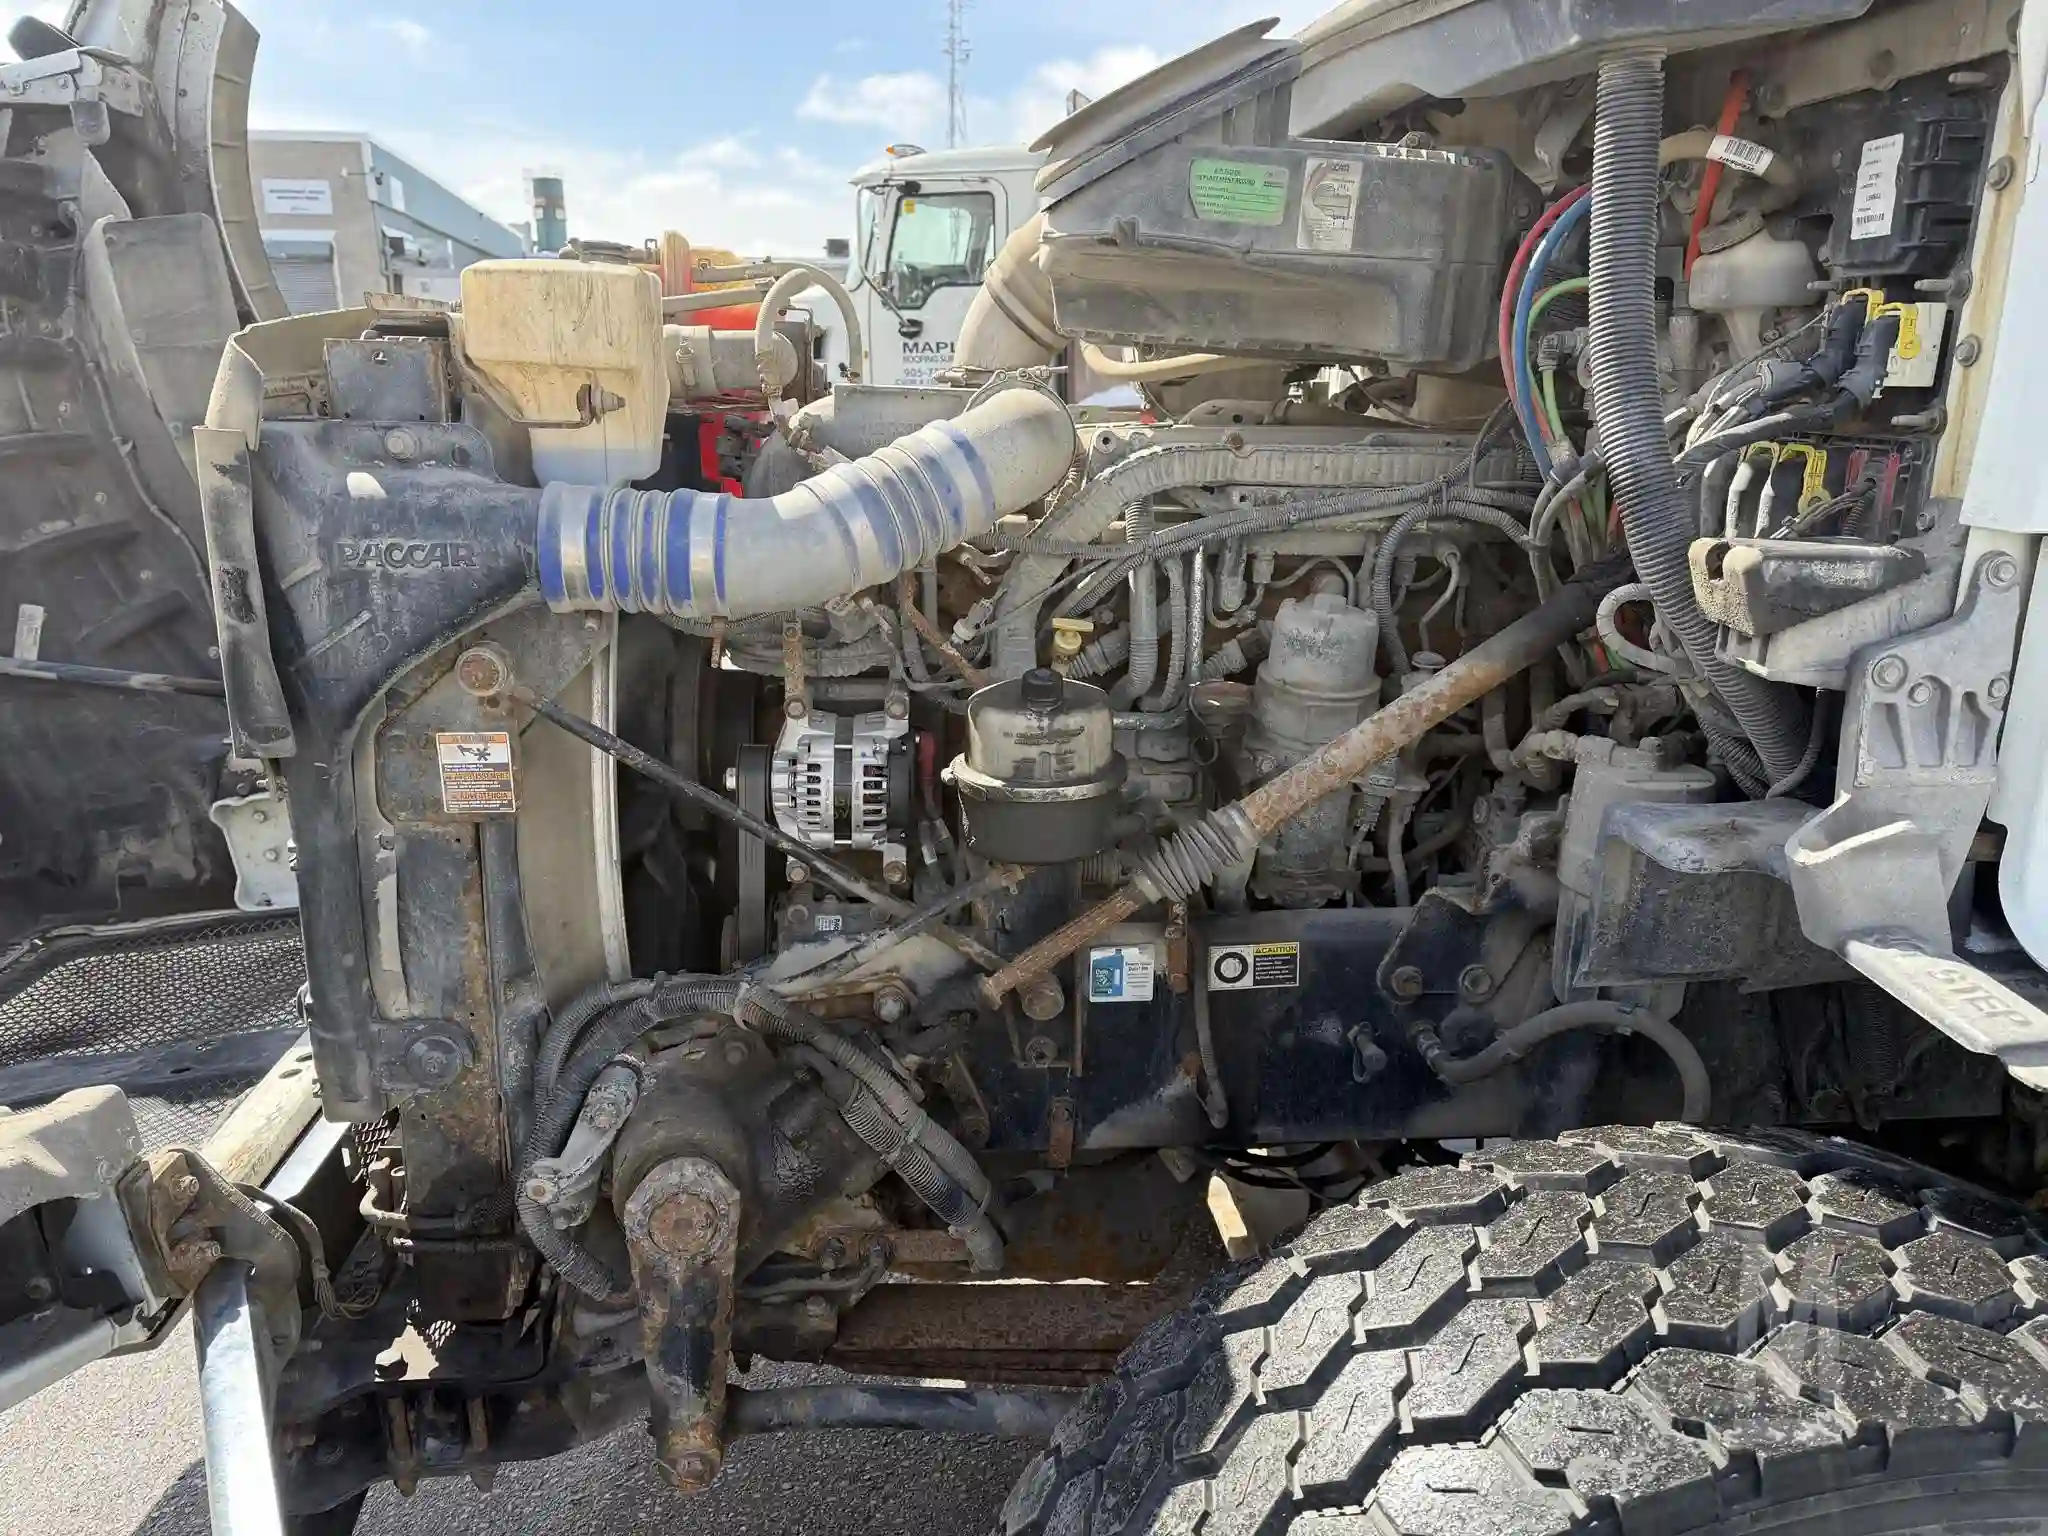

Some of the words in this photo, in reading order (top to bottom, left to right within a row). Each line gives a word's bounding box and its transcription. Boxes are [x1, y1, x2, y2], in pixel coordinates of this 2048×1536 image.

[337, 540, 478, 569] PACCAR
[1261, 945, 1297, 954] CAUTION
[1928, 967, 2034, 1027] STEP
